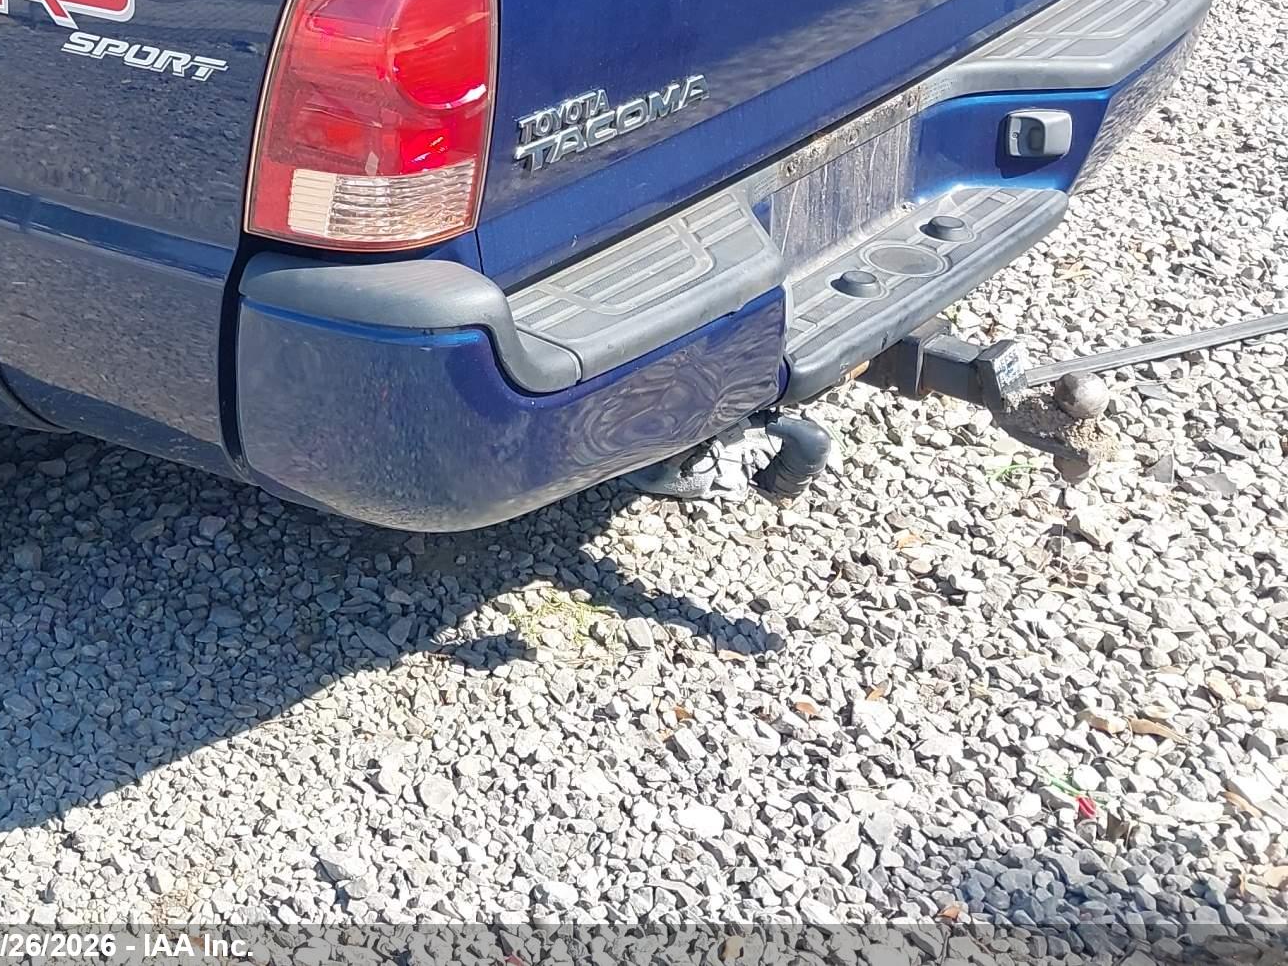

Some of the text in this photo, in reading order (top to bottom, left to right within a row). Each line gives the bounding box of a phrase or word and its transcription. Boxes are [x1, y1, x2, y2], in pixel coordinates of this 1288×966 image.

[61, 31, 228, 81] SPORT
[514, 74, 710, 174] TACOMA
[516, 89, 610, 143] TOYOTA
